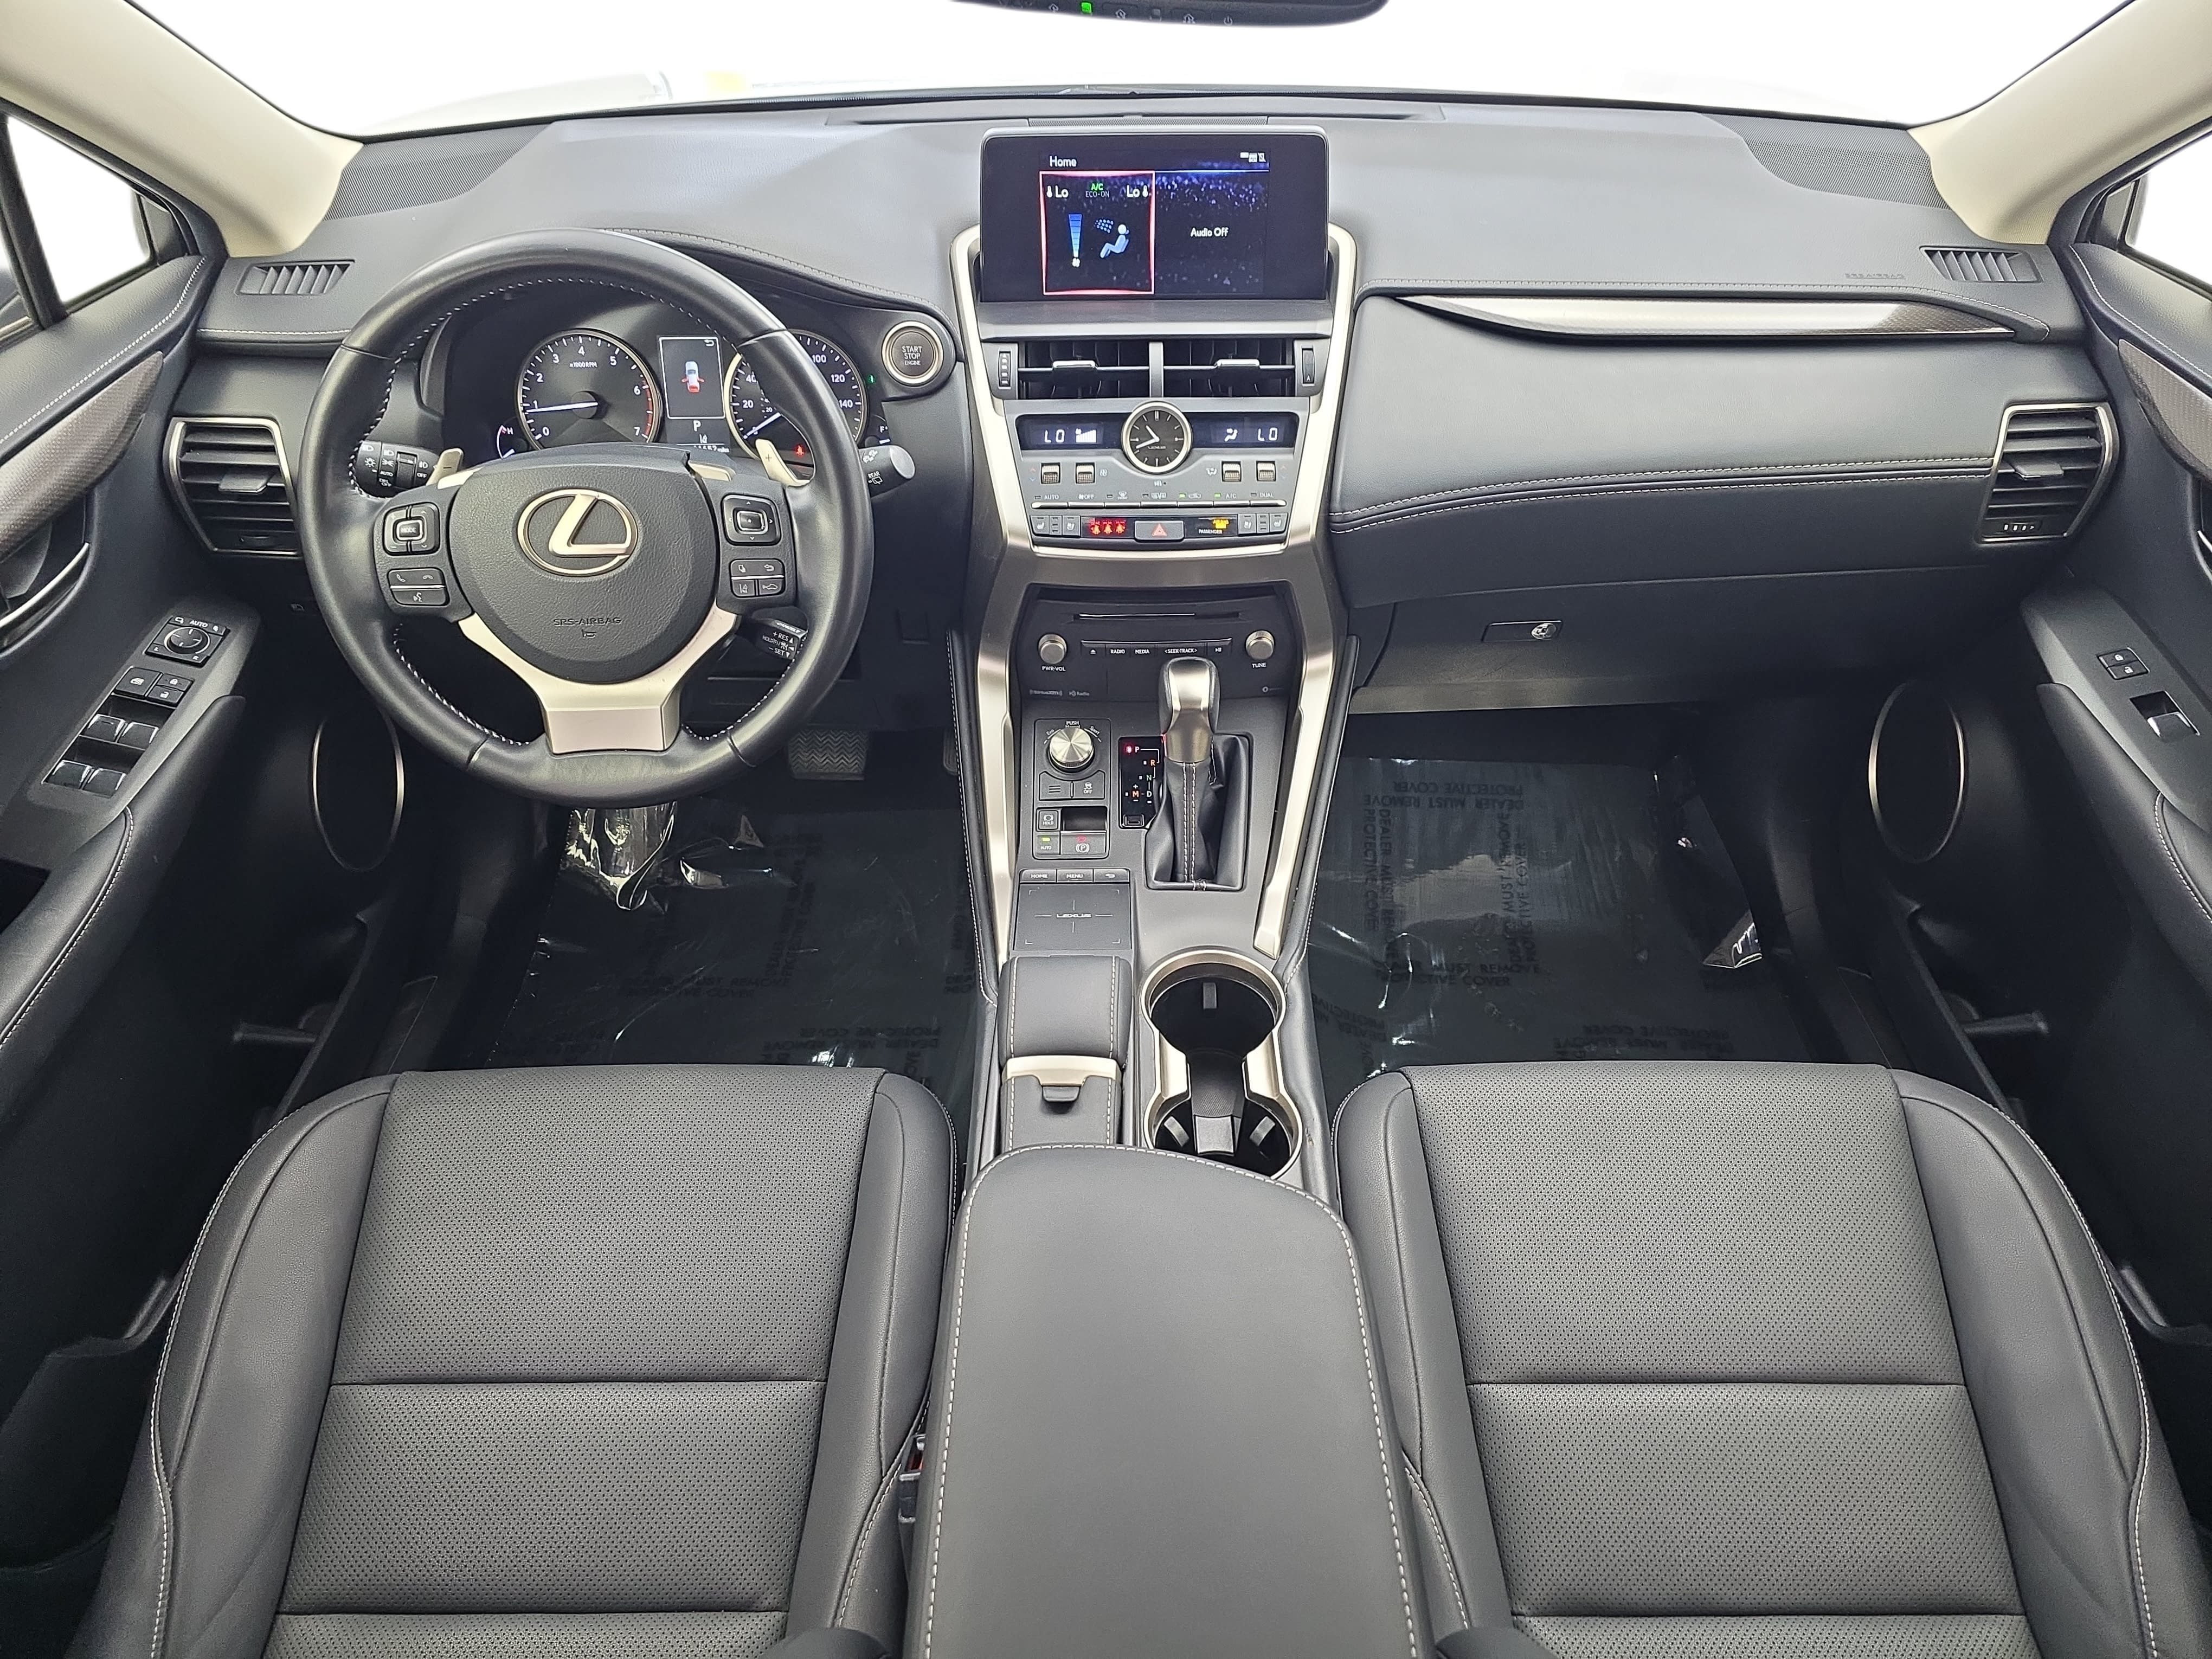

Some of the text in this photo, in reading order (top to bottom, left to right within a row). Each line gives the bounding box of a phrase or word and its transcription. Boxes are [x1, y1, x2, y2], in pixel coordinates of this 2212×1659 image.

[1050, 156, 1077, 167] Home
[1055, 185, 1069, 198] Lo
[1127, 185, 1140, 197] Lo
[1190, 227, 1229, 237] Audio Off
[578, 346, 586, 356] 4
[552, 353, 560, 363] 3
[610, 356, 617, 366] 5
[812, 355, 827, 363] 100
[536, 372, 544, 382] 2
[831, 374, 845, 382] 120
[634, 385, 641, 395] 6
[533, 400, 538, 409] 1
[742, 400, 754, 408] 20
[839, 400, 853, 408] 140
[693, 420, 702, 432] P
[507, 427, 513, 435] H
[542, 427, 550, 436] 0
[634, 427, 640, 436] 7
[1258, 427, 1278, 441] LO
[1044, 429, 1065, 443] LO
[868, 471, 880, 479] REAR
[778, 633, 789, 641] RES
[774, 648, 786, 656] SET
[1090, 726, 1100, 735] Sport
